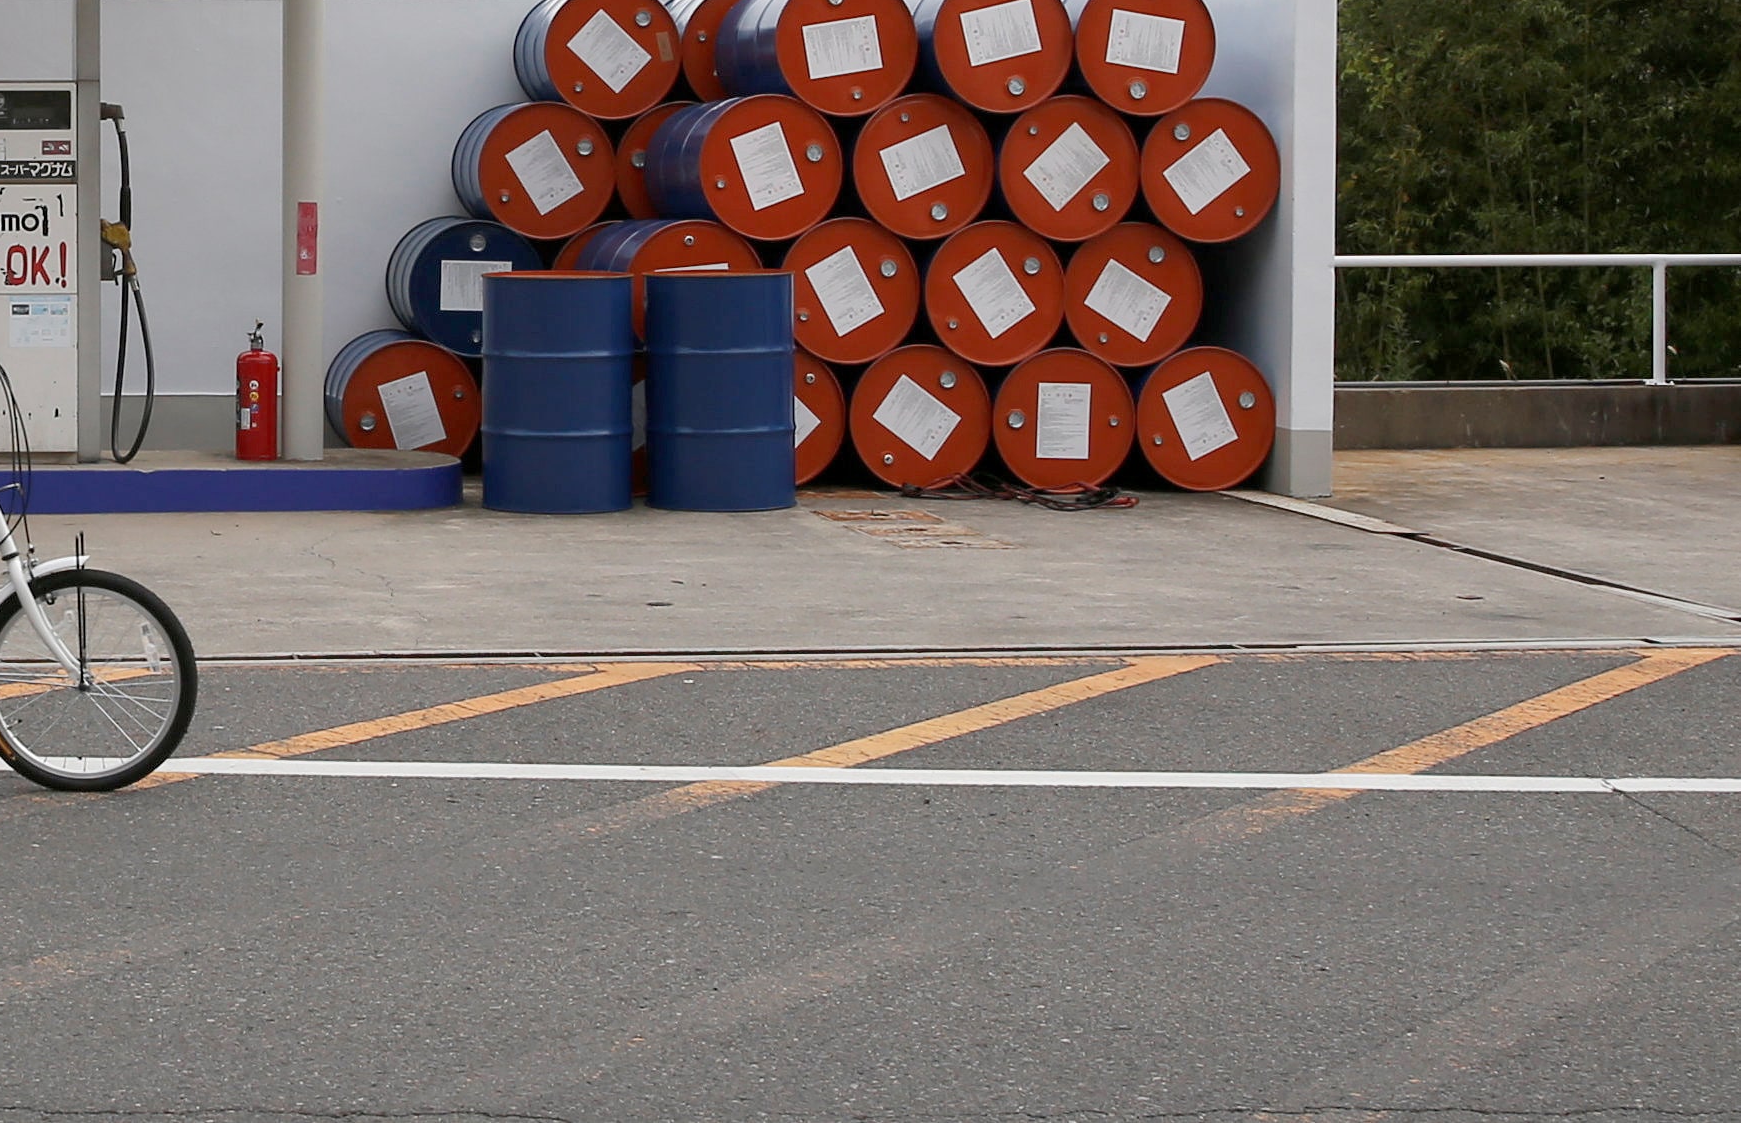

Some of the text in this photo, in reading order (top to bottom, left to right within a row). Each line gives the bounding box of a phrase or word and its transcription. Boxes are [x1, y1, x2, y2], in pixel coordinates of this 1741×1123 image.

[1, 163, 73, 177] スーパーマグナム
